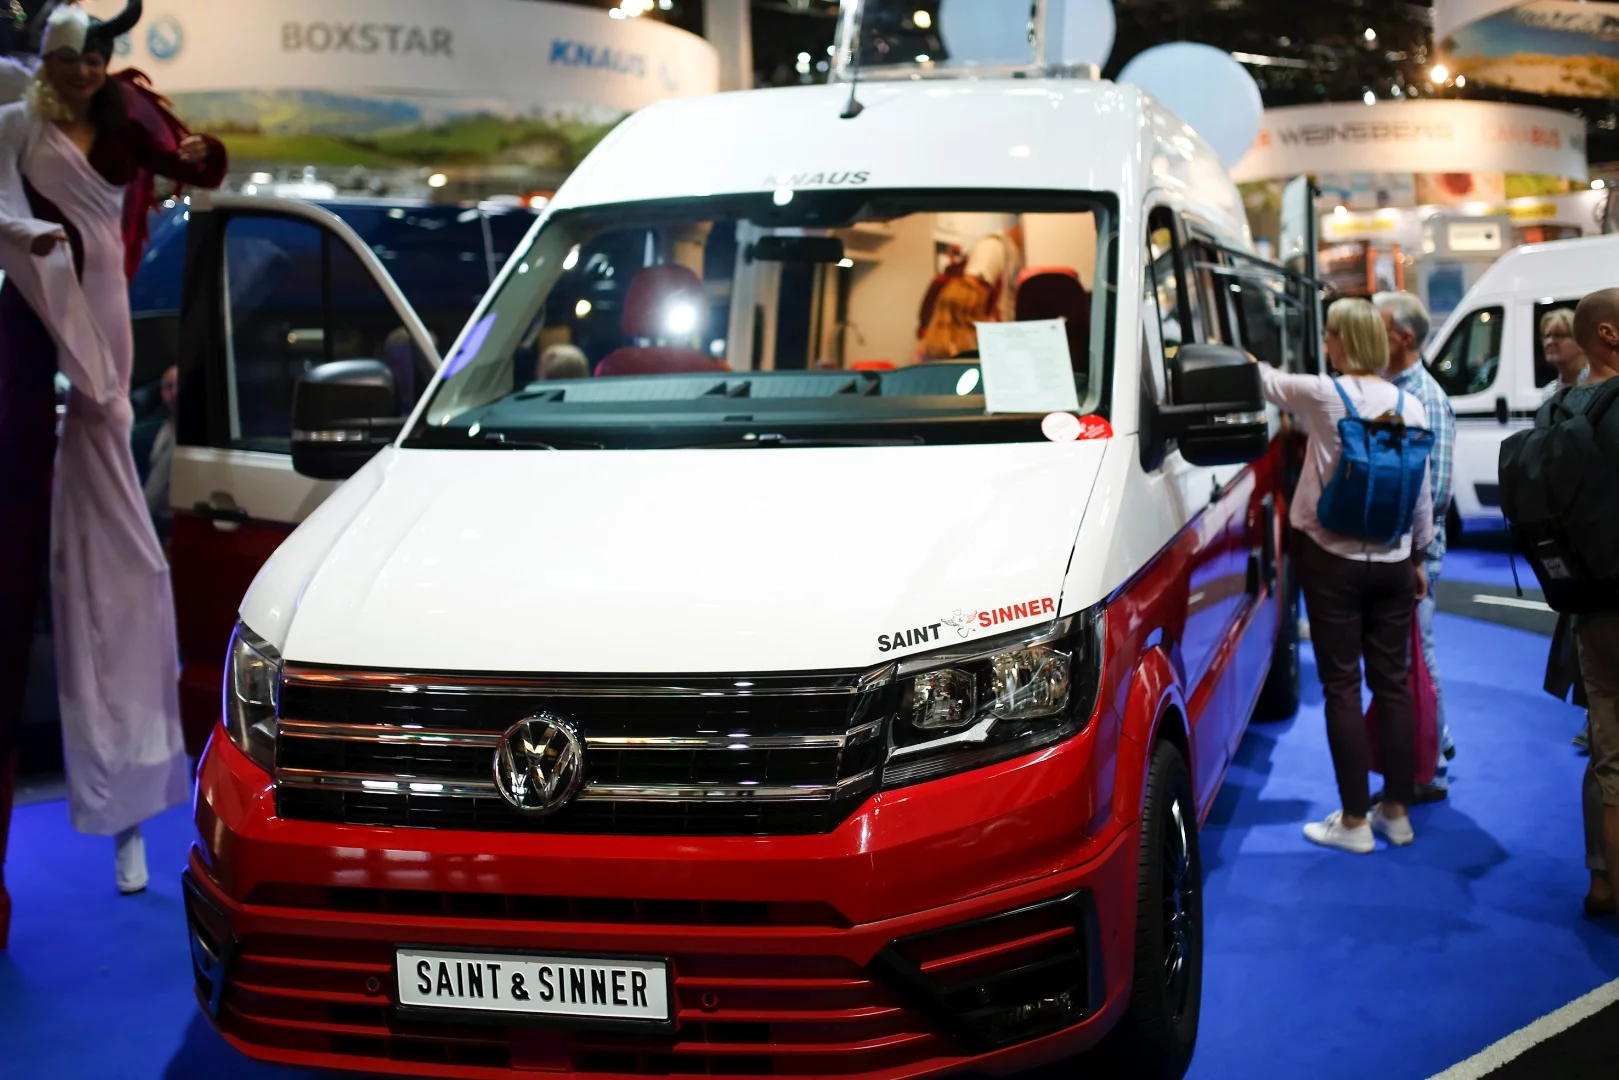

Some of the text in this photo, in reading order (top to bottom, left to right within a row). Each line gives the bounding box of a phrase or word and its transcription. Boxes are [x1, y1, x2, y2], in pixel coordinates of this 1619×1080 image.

[281, 21, 455, 58] BOXSTAR
[877, 596, 1056, 652] SAINT SINNER
[416, 959, 649, 1007] SAINT & SINNER
